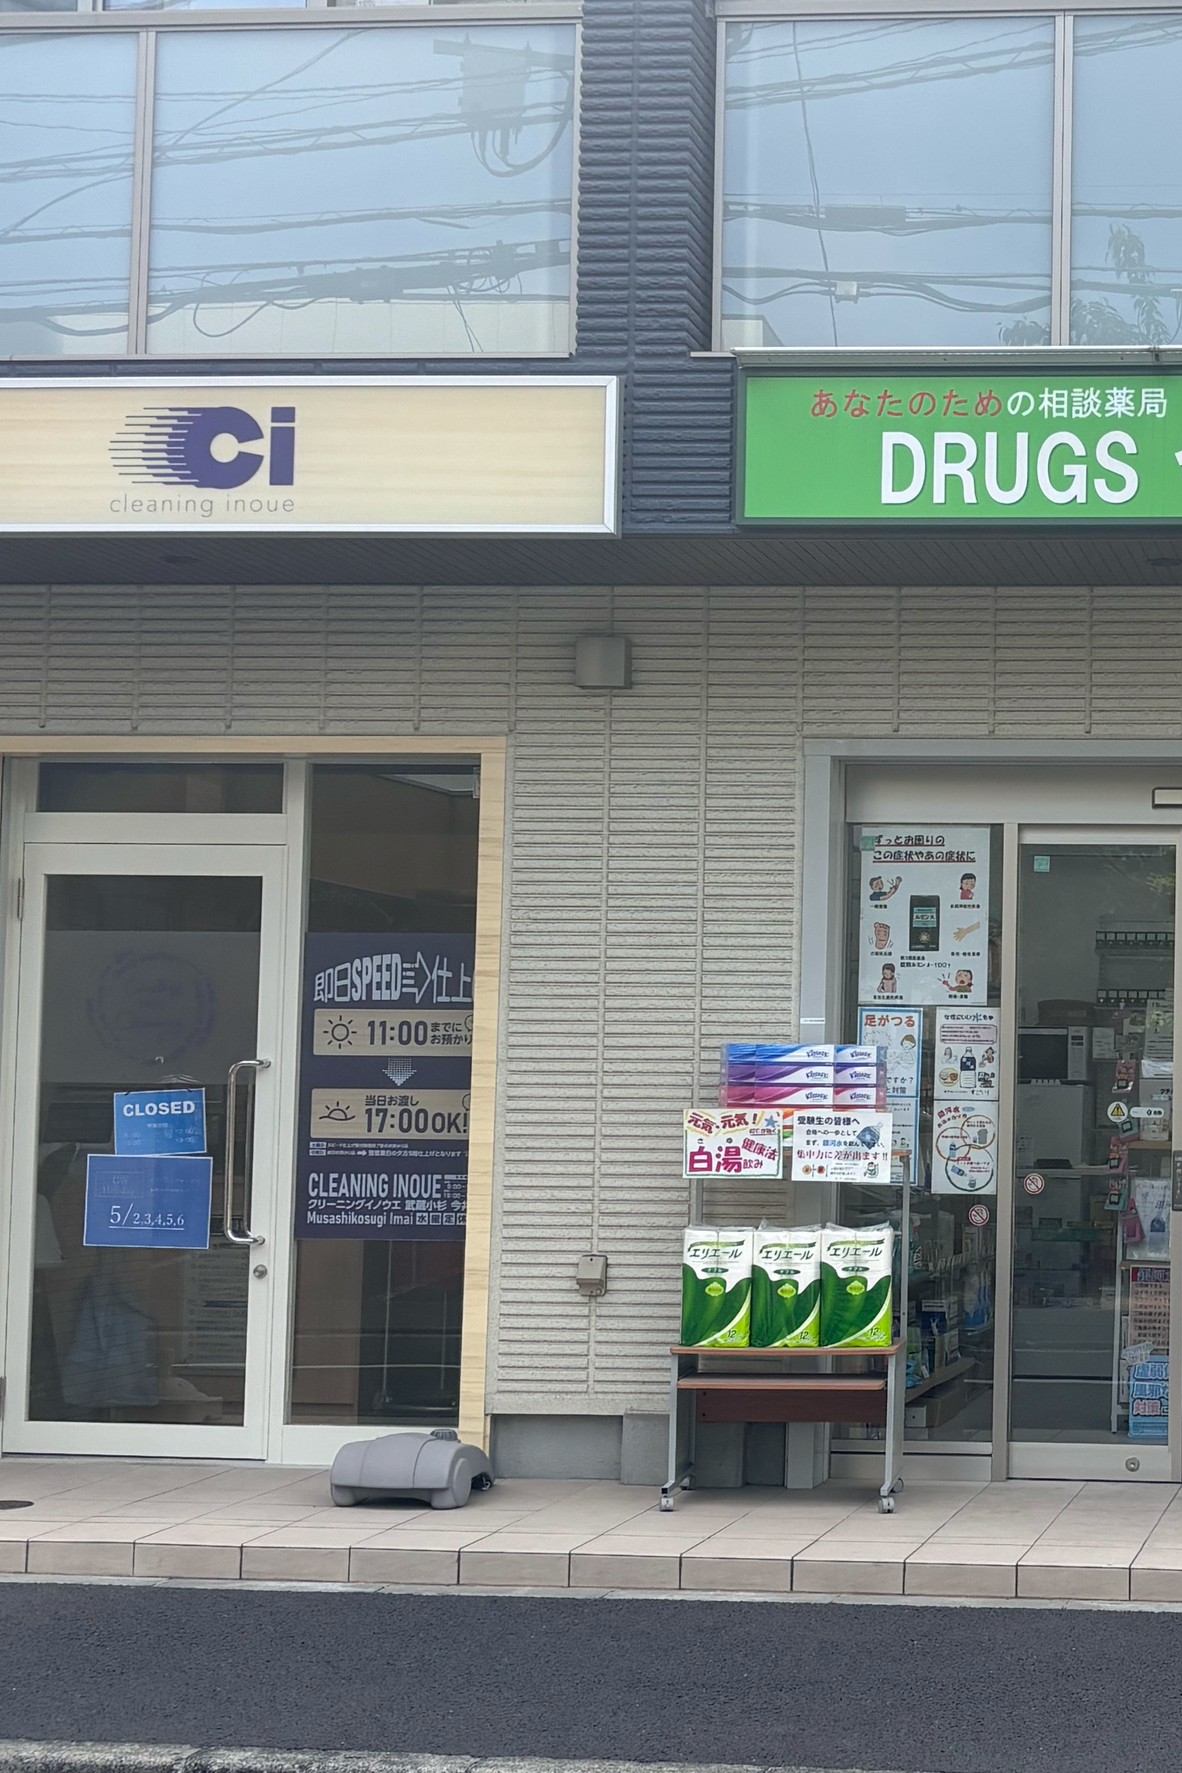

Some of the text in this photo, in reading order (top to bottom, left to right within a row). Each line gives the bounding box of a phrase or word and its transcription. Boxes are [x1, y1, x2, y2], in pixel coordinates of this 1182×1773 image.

[810, 387, 1168, 418] あなたのための相談薬局
[881, 431, 1139, 504] DRUGS
[110, 494, 295, 517] cleaning inoue
[873, 850, 976, 862] この症状やあの症状に
[430, 1022, 462, 1033] までに
[864, 1014, 916, 1027] 足がつる
[367, 1020, 428, 1045] 11:00
[365, 1095, 419, 1107] 当日お渡し
[123, 1101, 196, 1117] CLOSED
[797, 1116, 860, 1126] 受験生の皆様へ
[741, 1137, 778, 1160] 健康法
[689, 1146, 763, 1173] 白湯 飲み
[308, 1172, 389, 1198] CLEANING
[393, 1174, 442, 1198] INOUE
[308, 1200, 401, 1210] クリーニングイノウエ
[307, 1211, 387, 1228] Musashikosugi
[390, 1213, 413, 1225] Imai
[689, 1248, 743, 1260] エリエール
[761, 1249, 814, 1261] エリエール
[829, 1247, 883, 1258] エリエール
